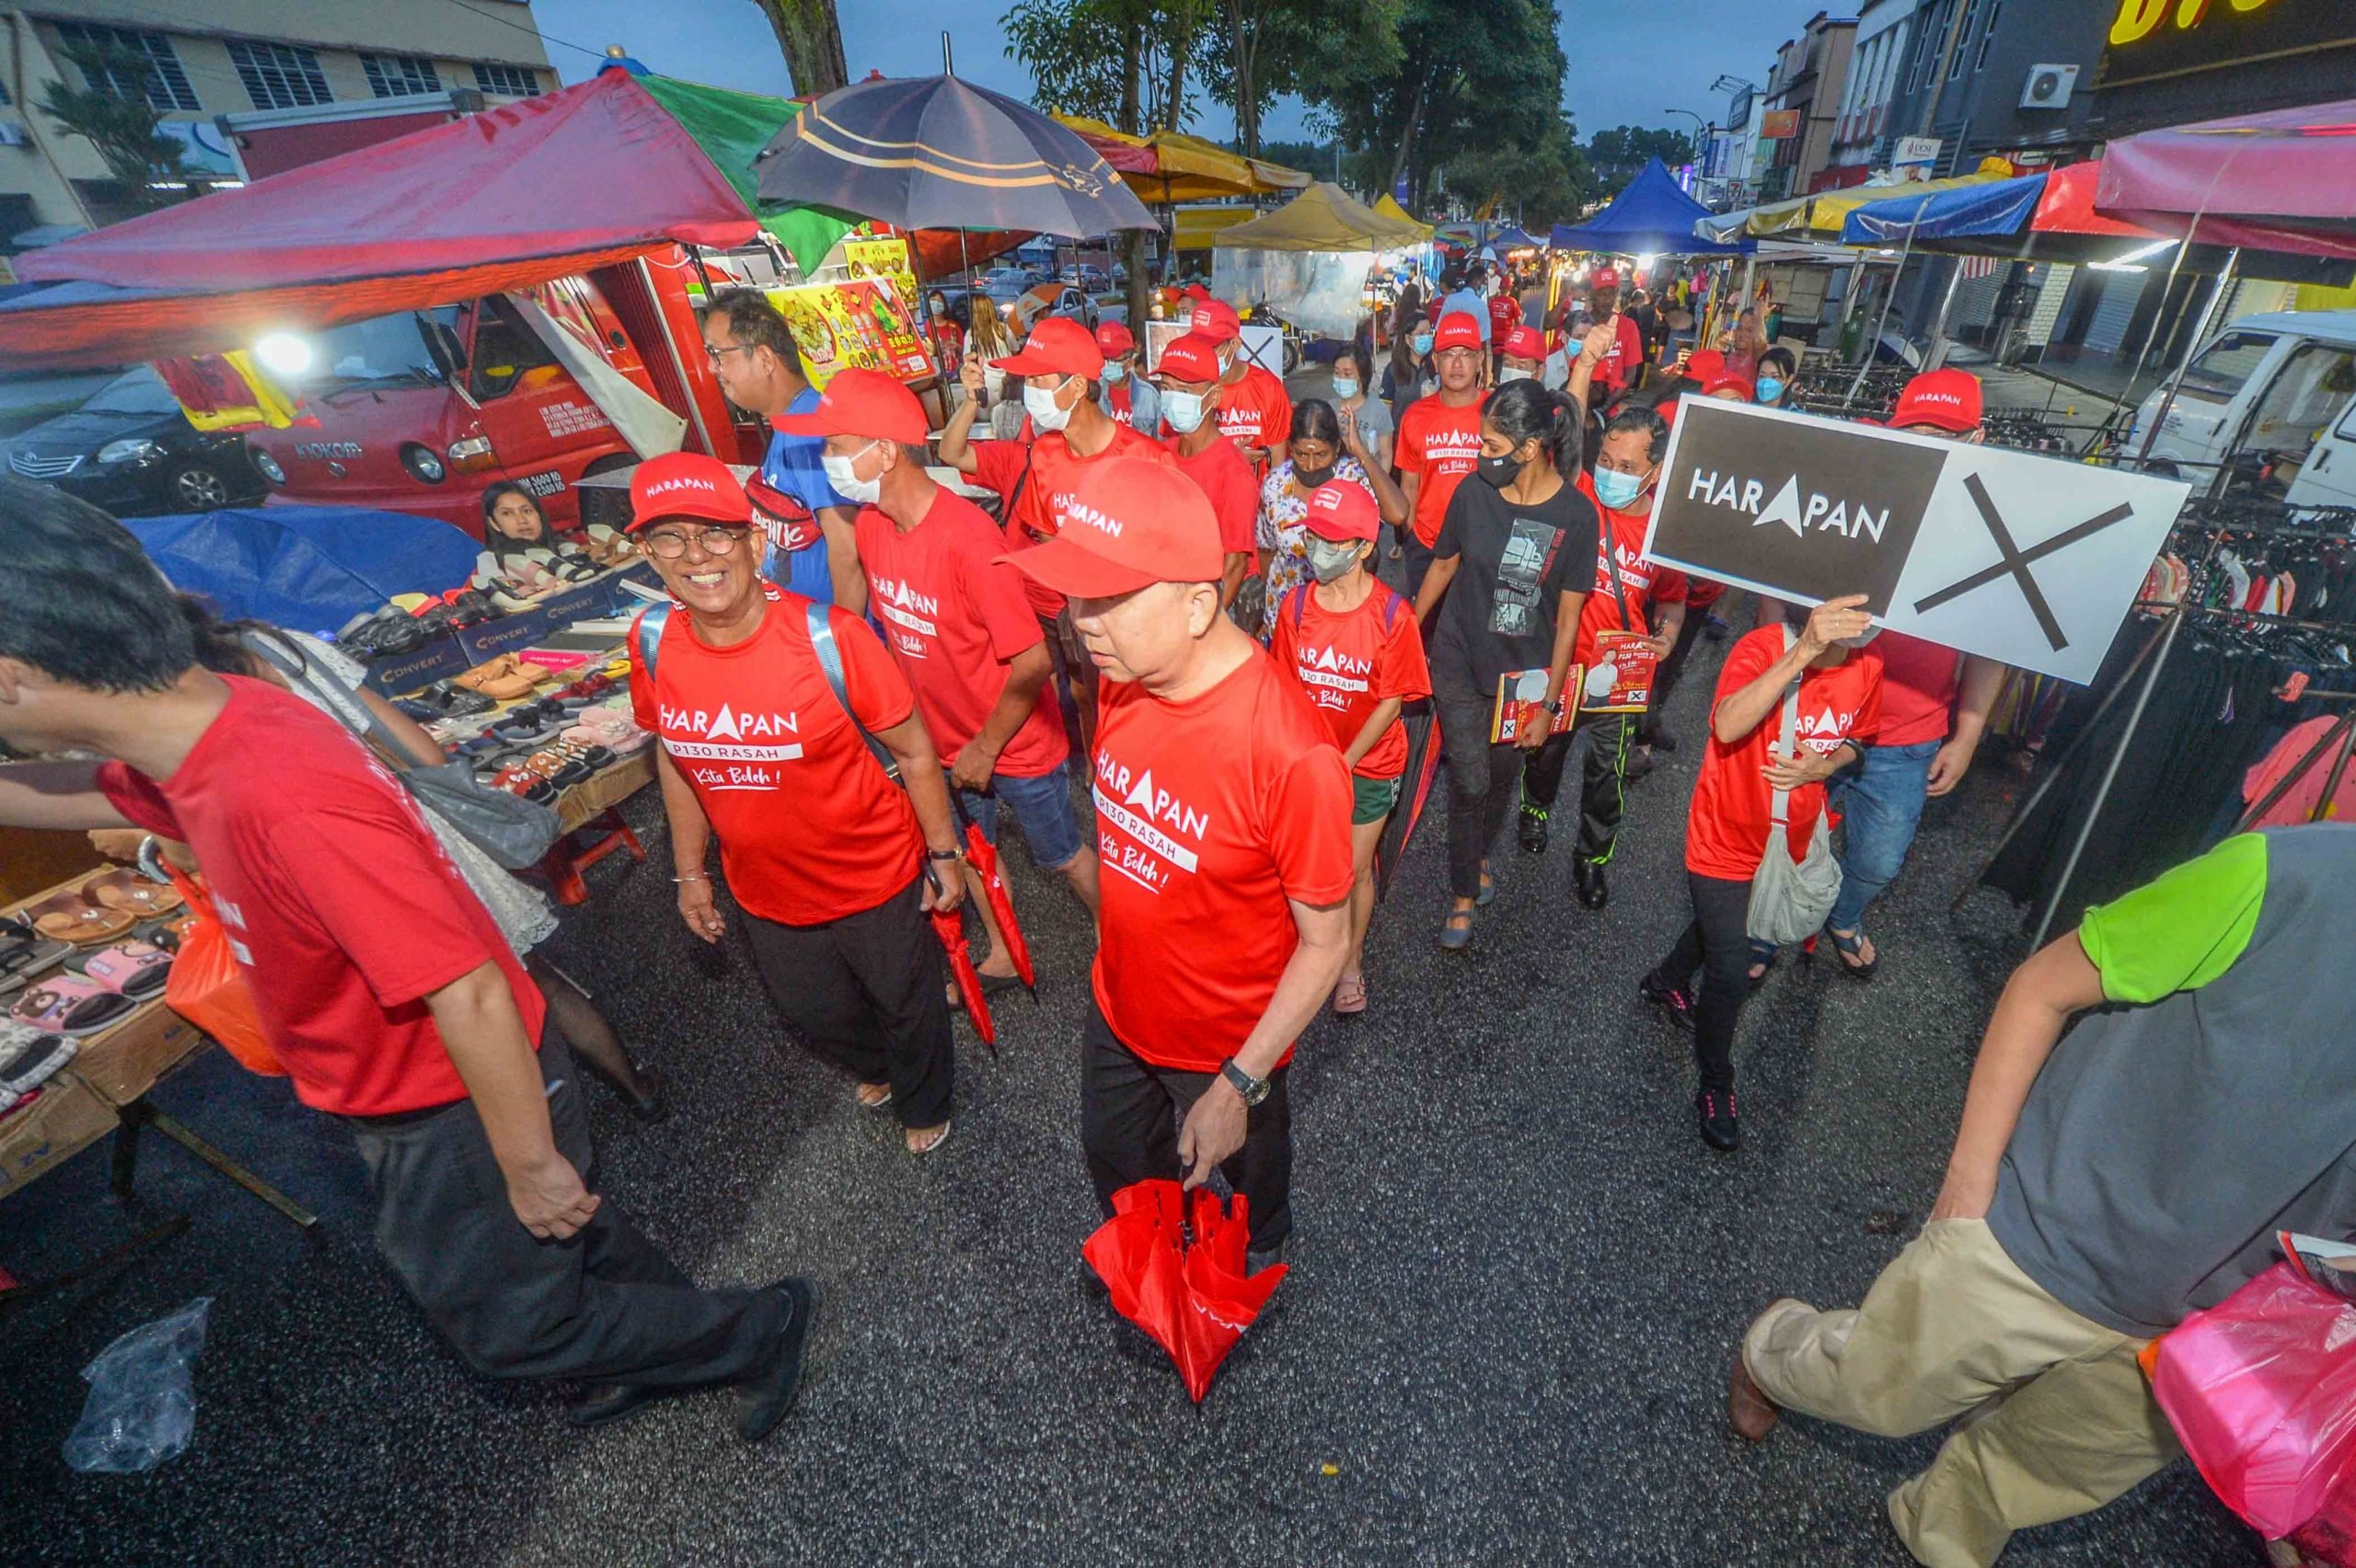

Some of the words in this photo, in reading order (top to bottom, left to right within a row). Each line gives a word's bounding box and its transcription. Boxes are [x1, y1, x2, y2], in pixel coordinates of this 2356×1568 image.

[1214, 406, 1261, 426] ARAPAN
[646, 478, 715, 498] HARAPAN
[1688, 467, 1889, 544] HARAPAN
[1621, 572, 1640, 585] SAH
[547, 596, 594, 618] CONVERT
[872, 571, 938, 617] HARAPAN
[475, 626, 530, 649] CONVERT
[380, 652, 445, 683] CONVERT
[1298, 644, 1372, 675] ARAPAN
[1321, 675, 1355, 689] RASAH
[660, 702, 798, 742] HARAPAN
[673, 744, 712, 756] P130
[718, 747, 779, 759] RASAH
[692, 767, 725, 785] Kita
[726, 766, 770, 785] Boleh
[1097, 748, 1209, 841] HARAPAN
[1099, 798, 1126, 824] P130
[1129, 819, 1176, 859] RASAH
[1101, 831, 1120, 860] Kita
[1123, 844, 1158, 882] Boleh
